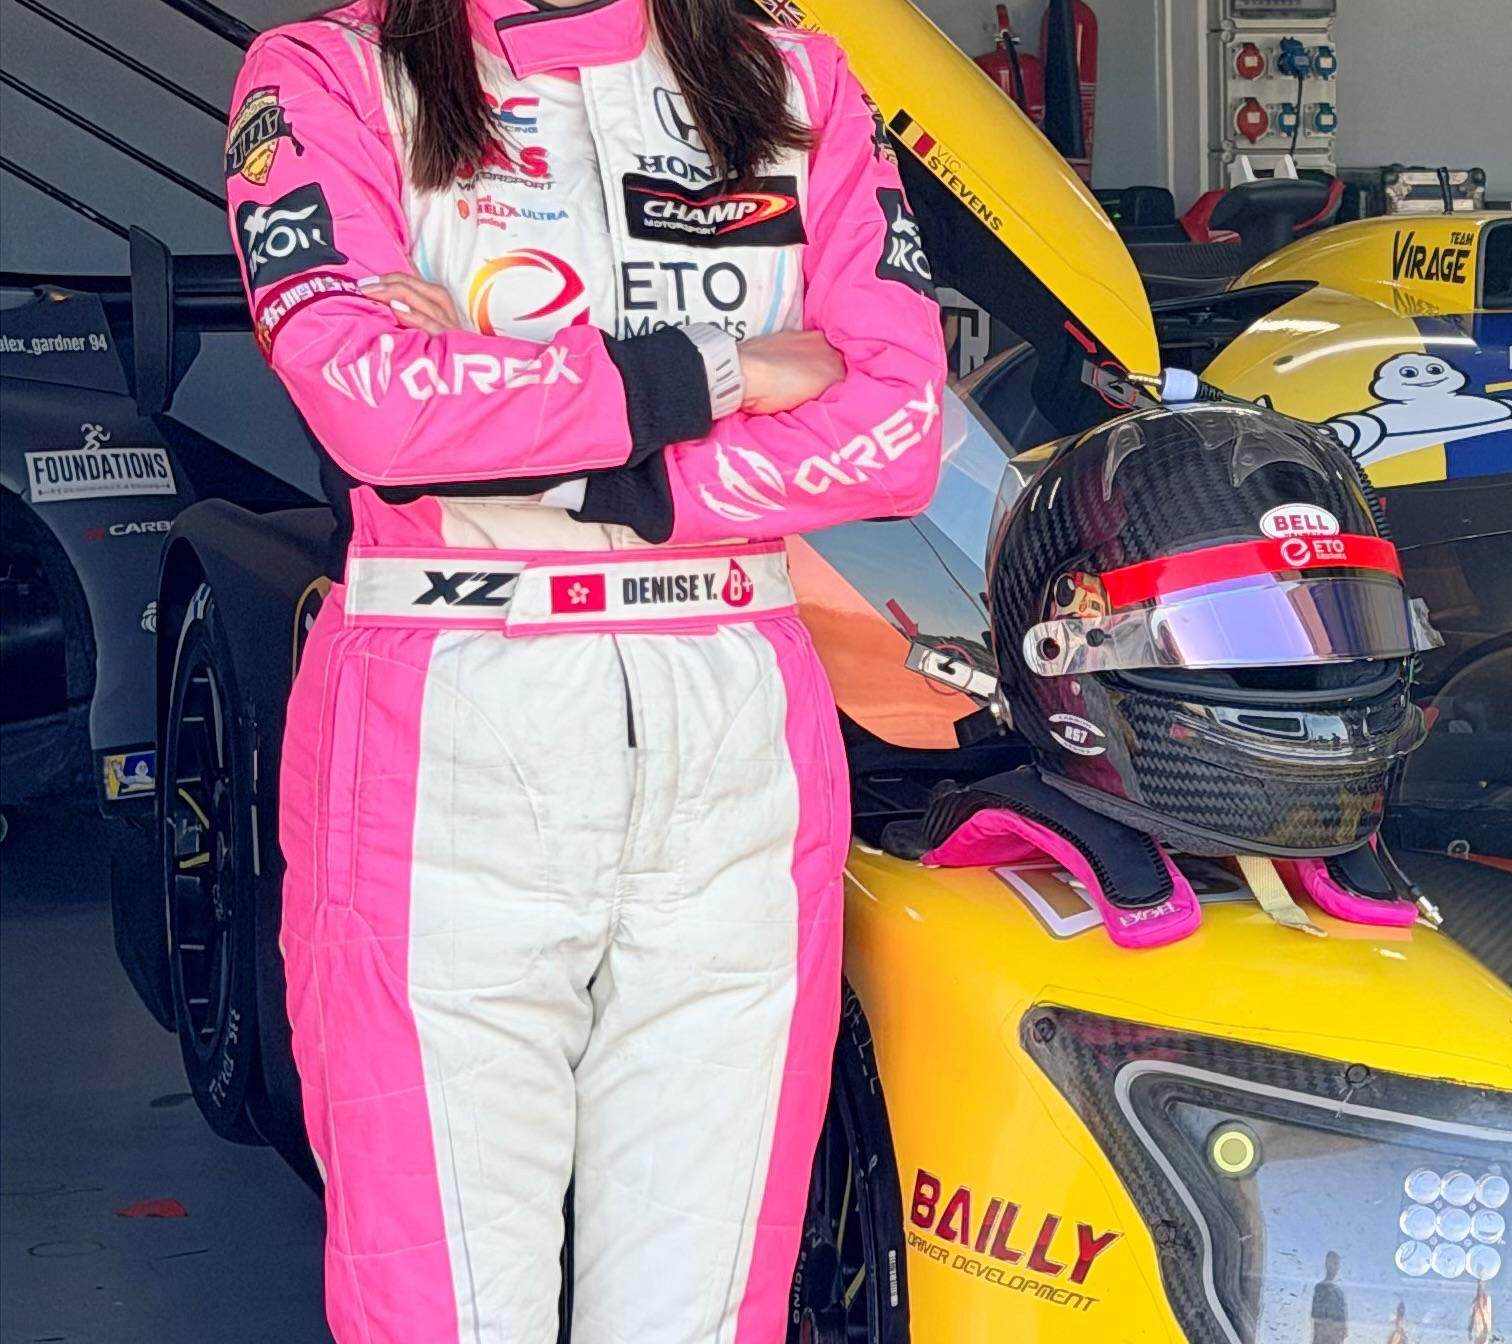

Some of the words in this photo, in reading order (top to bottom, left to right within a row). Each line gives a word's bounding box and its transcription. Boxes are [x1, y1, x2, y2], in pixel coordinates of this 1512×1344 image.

[632, 153, 725, 184] HON
[936, 144, 963, 175] VIC
[927, 155, 1003, 233] STEVENS
[520, 208, 569, 221] ULTRA
[643, 200, 758, 226] CHAMP
[643, 218, 717, 235] MOTORSPORT
[1450, 231, 1475, 246] TEAM
[1392, 230, 1471, 285] VIRAGE
[621, 260, 748, 312] ETO
[88, 333, 108, 351] 94
[32, 451, 168, 485] FOUNDATIONS
[109, 519, 175, 536] CARB
[1273, 515, 1330, 532] BELL
[1312, 540, 1345, 553] ETO
[623, 573, 699, 605] DENISE
[703, 573, 718, 600] Y.
[730, 567, 754, 601] B+
[911, 1168, 1124, 1286] BAILLY
[907, 1231, 950, 1265] DRIVER
[951, 1254, 1100, 1312] DEVELOPMENT
